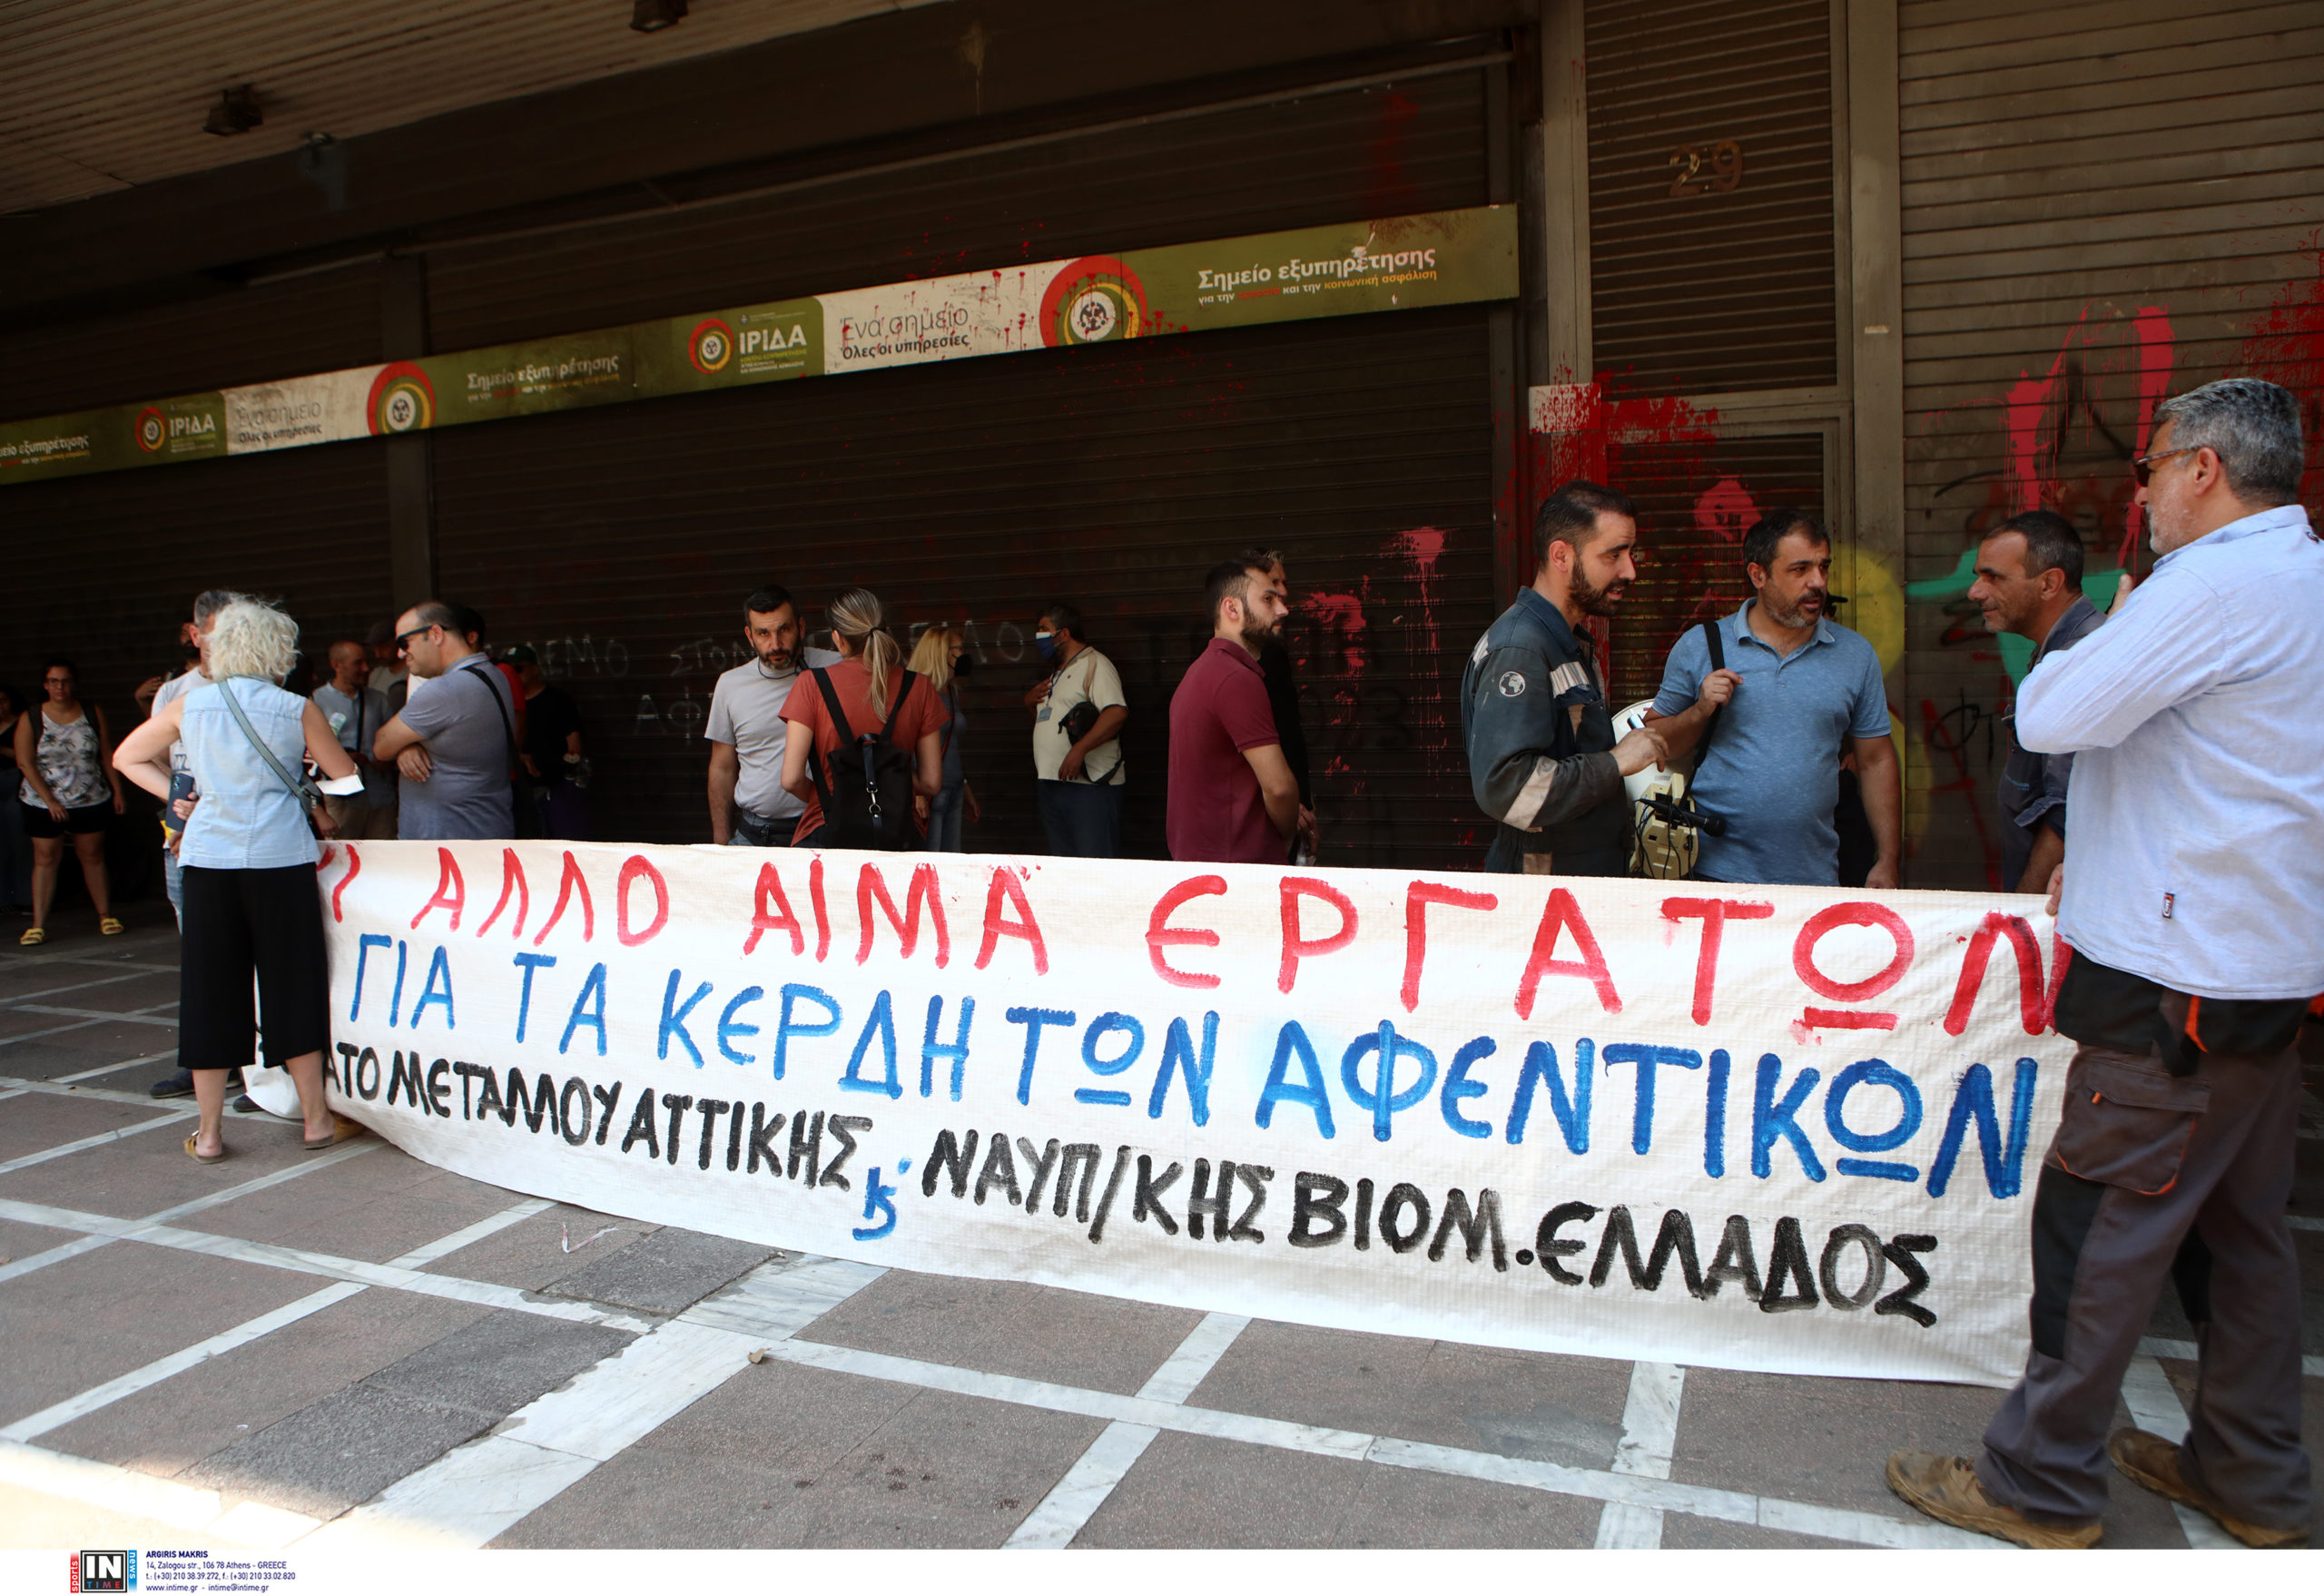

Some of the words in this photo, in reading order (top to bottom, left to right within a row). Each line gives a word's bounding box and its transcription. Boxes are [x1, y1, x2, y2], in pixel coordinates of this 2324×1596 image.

[1669, 139, 1743, 197] 29
[1197, 262, 1272, 292] Σημείο
[1277, 247, 1436, 281] εξυπηρέτησης
[1197, 295, 1215, 307] για
[1216, 291, 1236, 304] την
[1283, 284, 1300, 295] και
[1302, 282, 1322, 294] την
[1324, 273, 1379, 290] κοινωνική
[1381, 269, 1438, 285] ασφάλιση
[739, 323, 807, 355] ΙΡΙΔΑ
[840, 316, 881, 340] Ένα
[889, 303, 969, 338] σημείο
[840, 344, 876, 360] Όλες
[878, 344, 892, 355] οι
[895, 333, 970, 355] υπηρεσίες
[466, 368, 516, 392] Σημείο
[517, 355, 619, 384] εξυπηρέτησης
[169, 413, 217, 438] ΙΡΙΔΑ
[410, 846, 670, 948] ΑΛΛΟ
[743, 858, 1050, 977] ΑΙΜΑ
[1144, 873, 2073, 1038] ΕΡΓΑΤΩΝ
[350, 934, 456, 1030] ΓΙΑ
[513, 951, 608, 1057] ΤΑ
[657, 968, 975, 1103] ΚΕΡΔΗ
[1005, 1005, 1221, 1128] ΤΩΝ
[1255, 1019, 2039, 1199] ΑΦΕΝΤΙΚΩΝ
[621, 1087, 874, 1193] ΑΤΤΙΚΗΣ
